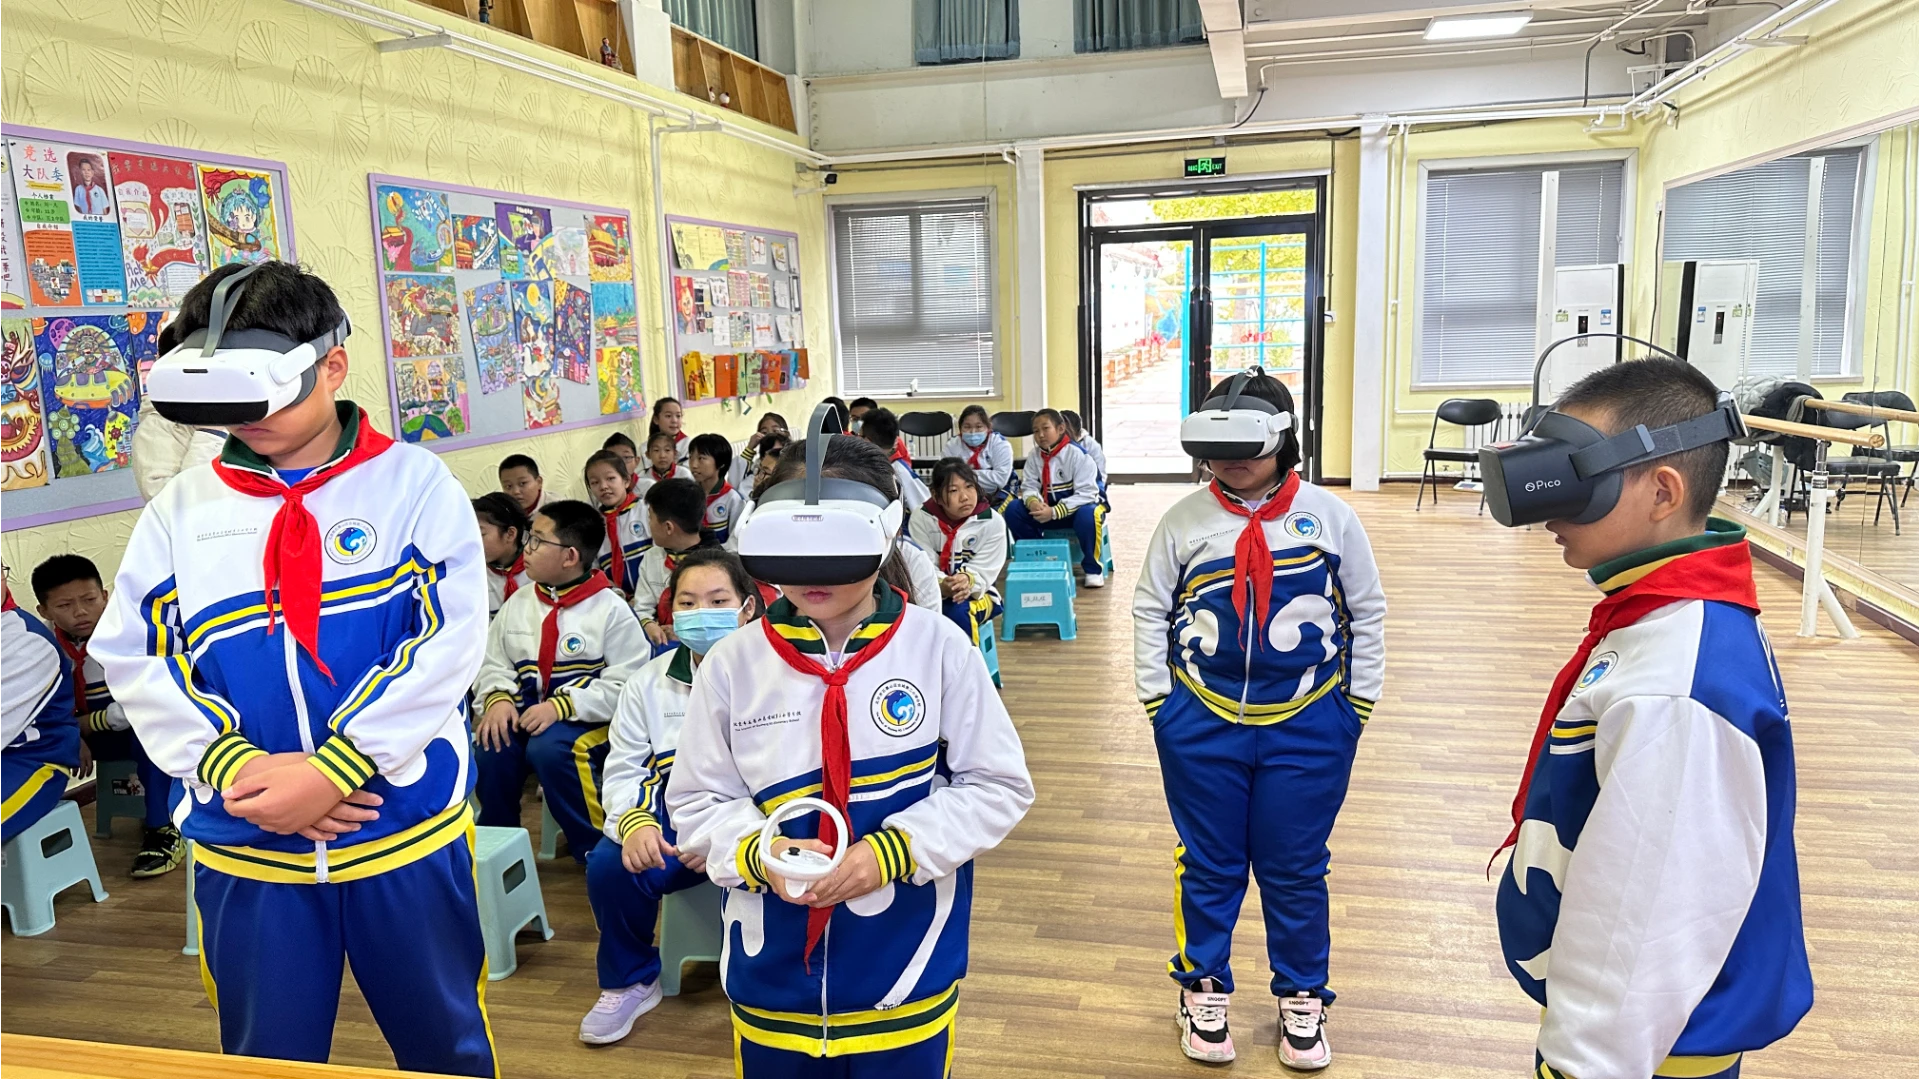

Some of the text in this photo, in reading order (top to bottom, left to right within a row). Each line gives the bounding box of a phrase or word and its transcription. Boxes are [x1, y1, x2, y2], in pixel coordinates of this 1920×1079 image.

[23, 144, 58, 164] 竞选
[23, 164, 64, 182] 大队委
[130, 276, 147, 288] Me
[1536, 480, 1561, 490] Pico
